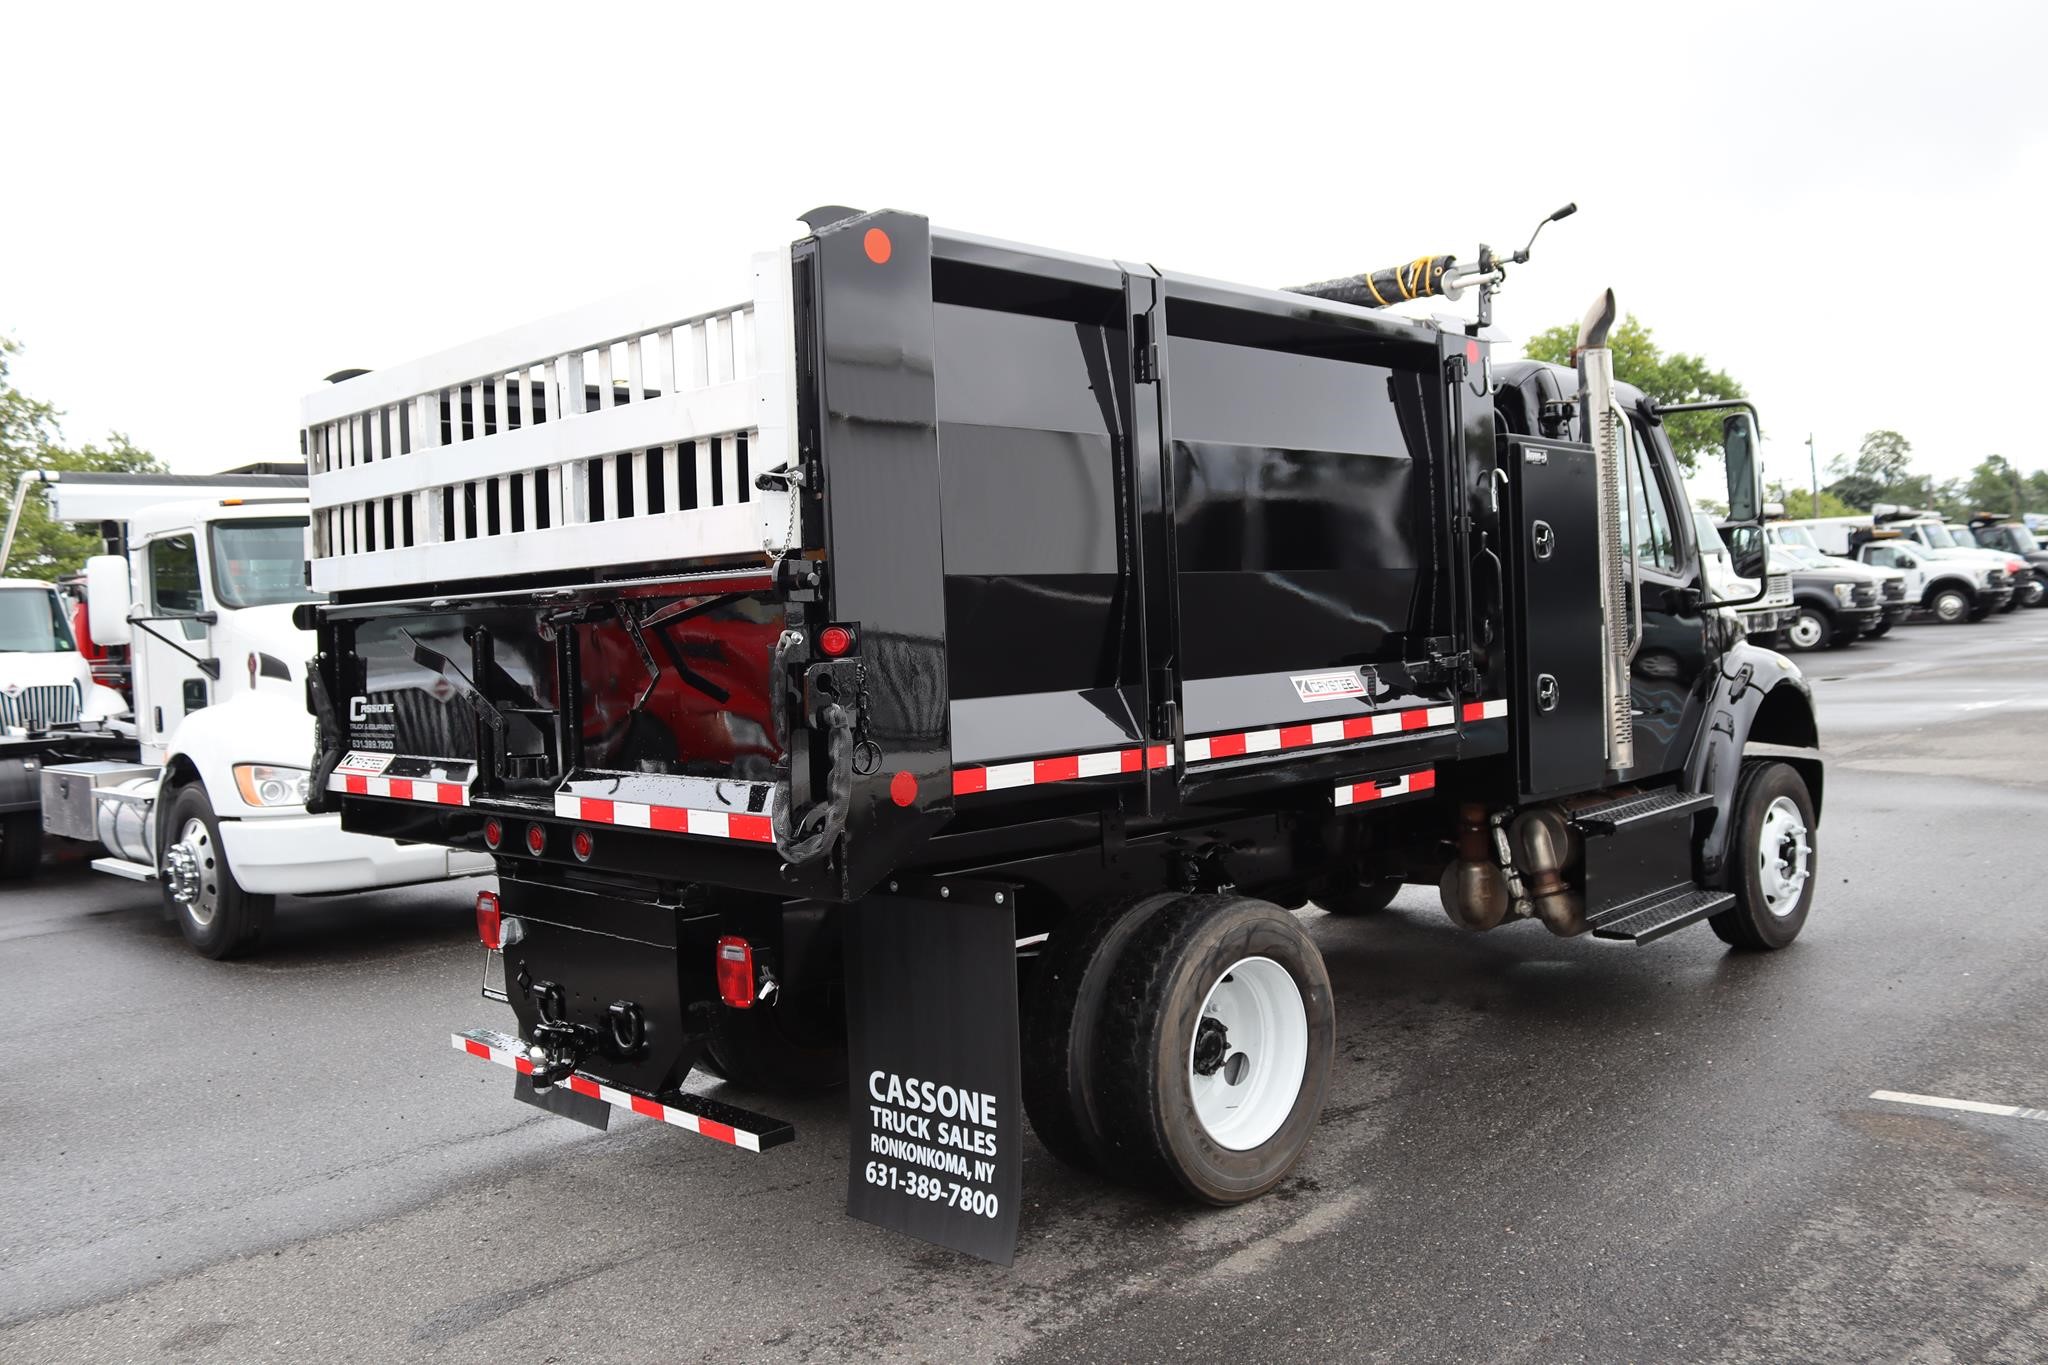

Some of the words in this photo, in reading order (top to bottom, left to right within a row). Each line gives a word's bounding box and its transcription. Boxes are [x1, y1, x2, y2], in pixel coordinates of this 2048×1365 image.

[350, 696, 394, 722] CASSONE
[869, 1070, 997, 1128] CASSONE
[869, 1105, 931, 1141] TRUCK
[938, 1122, 997, 1157] SALES
[870, 1133, 972, 1181] RONKONKOMA,
[974, 1160, 996, 1184] NY
[865, 1161, 998, 1219] 631-389-7800
